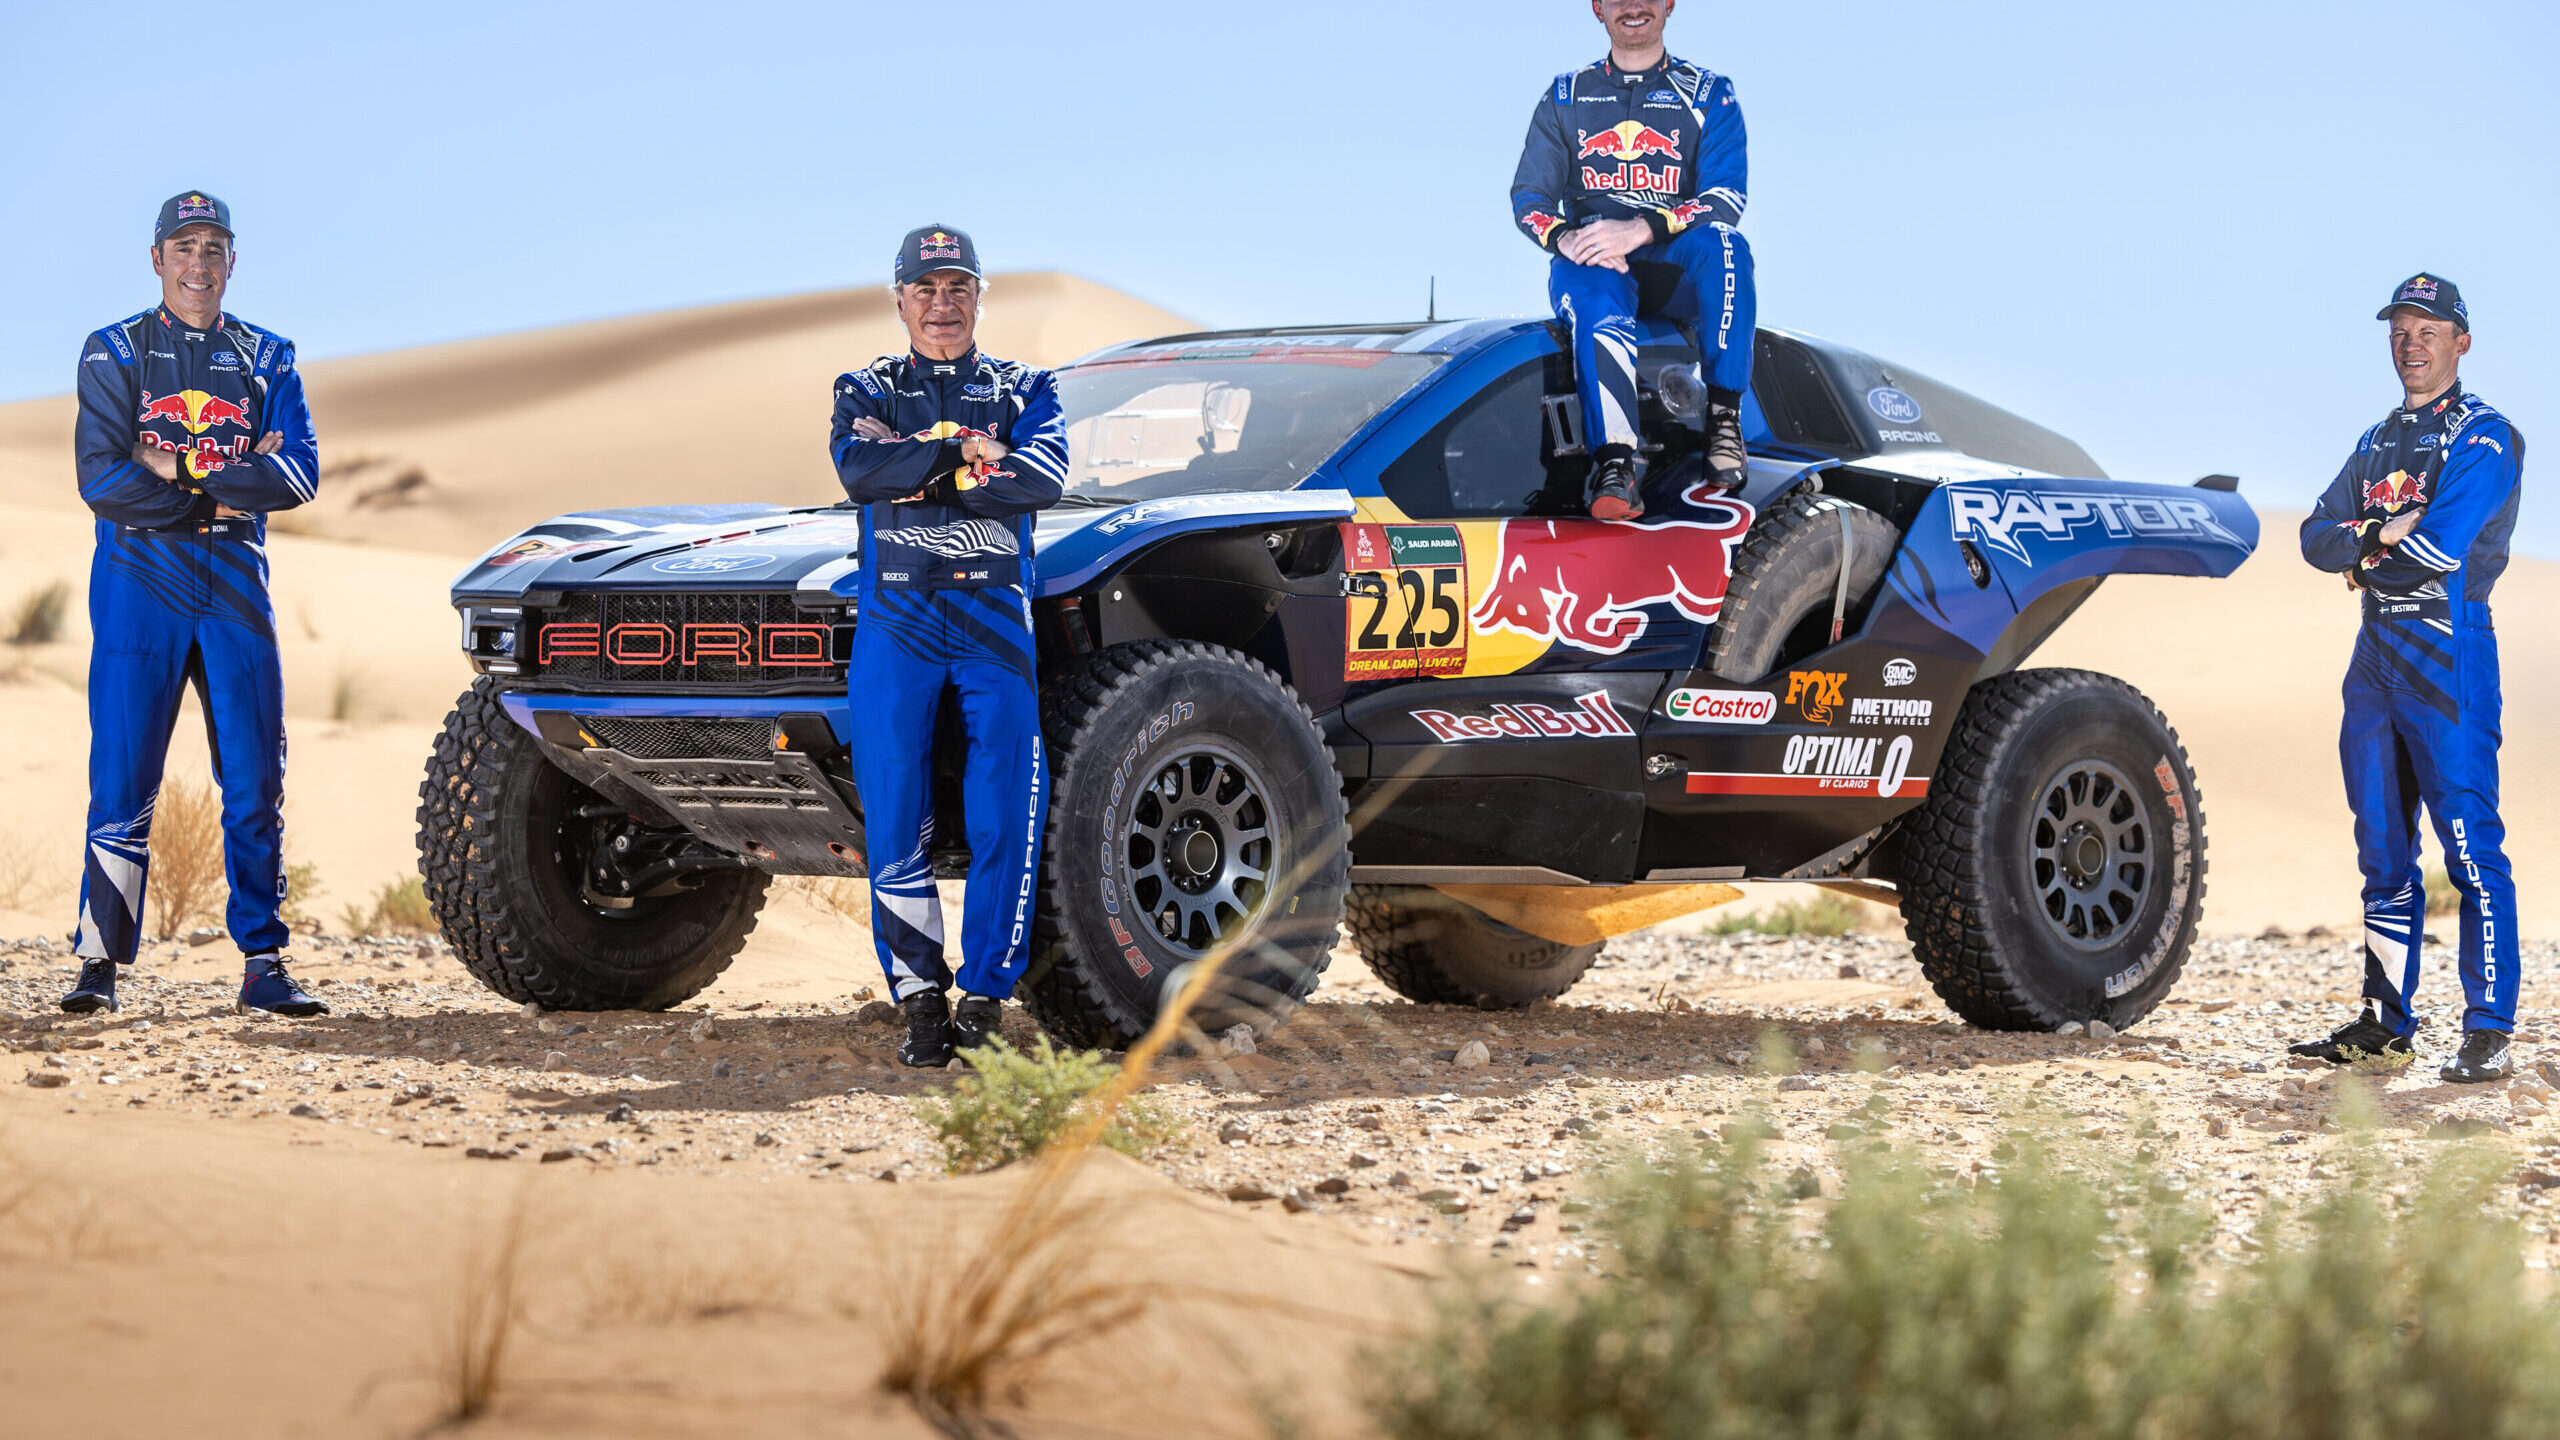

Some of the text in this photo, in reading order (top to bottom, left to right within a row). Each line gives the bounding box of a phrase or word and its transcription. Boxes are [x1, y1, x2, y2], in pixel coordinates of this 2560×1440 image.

[1653, 92, 1674, 101] Ford
[1581, 163, 1681, 193] Red Bull
[179, 207, 216, 219] Red Bull
[921, 247, 960, 260] Red Bull
[2417, 289, 2436, 301] Bull
[1718, 272, 1736, 350] FORD
[107, 329, 131, 360] sparco
[259, 340, 279, 370] sparco
[1879, 392, 1914, 418] Ford
[1878, 430, 1942, 443] RACING
[212, 525, 229, 533] ROMA
[1948, 487, 2256, 563] RAPTOR
[1408, 540, 1458, 549] SAUDI ARABIA
[668, 552, 756, 570] Ford
[882, 572, 909, 581] sparco
[969, 571, 989, 580] SAINZ
[1358, 569, 1459, 649] 225
[539, 623, 836, 666] FORD
[1349, 660, 1391, 671] DREAM.
[1424, 658, 1449, 668] LIVE
[1449, 657, 1463, 666] IT.
[1887, 665, 1914, 679] BMC
[1692, 695, 1772, 719] Castrol
[1785, 670, 1848, 728] FOX
[1851, 698, 1933, 717] METHOD
[1409, 689, 1637, 743] Red Bull
[1850, 716, 1930, 726] RACE WHEELS
[1819, 779, 1869, 788] BY CLARIOS
[1002, 736, 1040, 968] FORD RACING
[2485, 921, 2496, 1003] FORD
